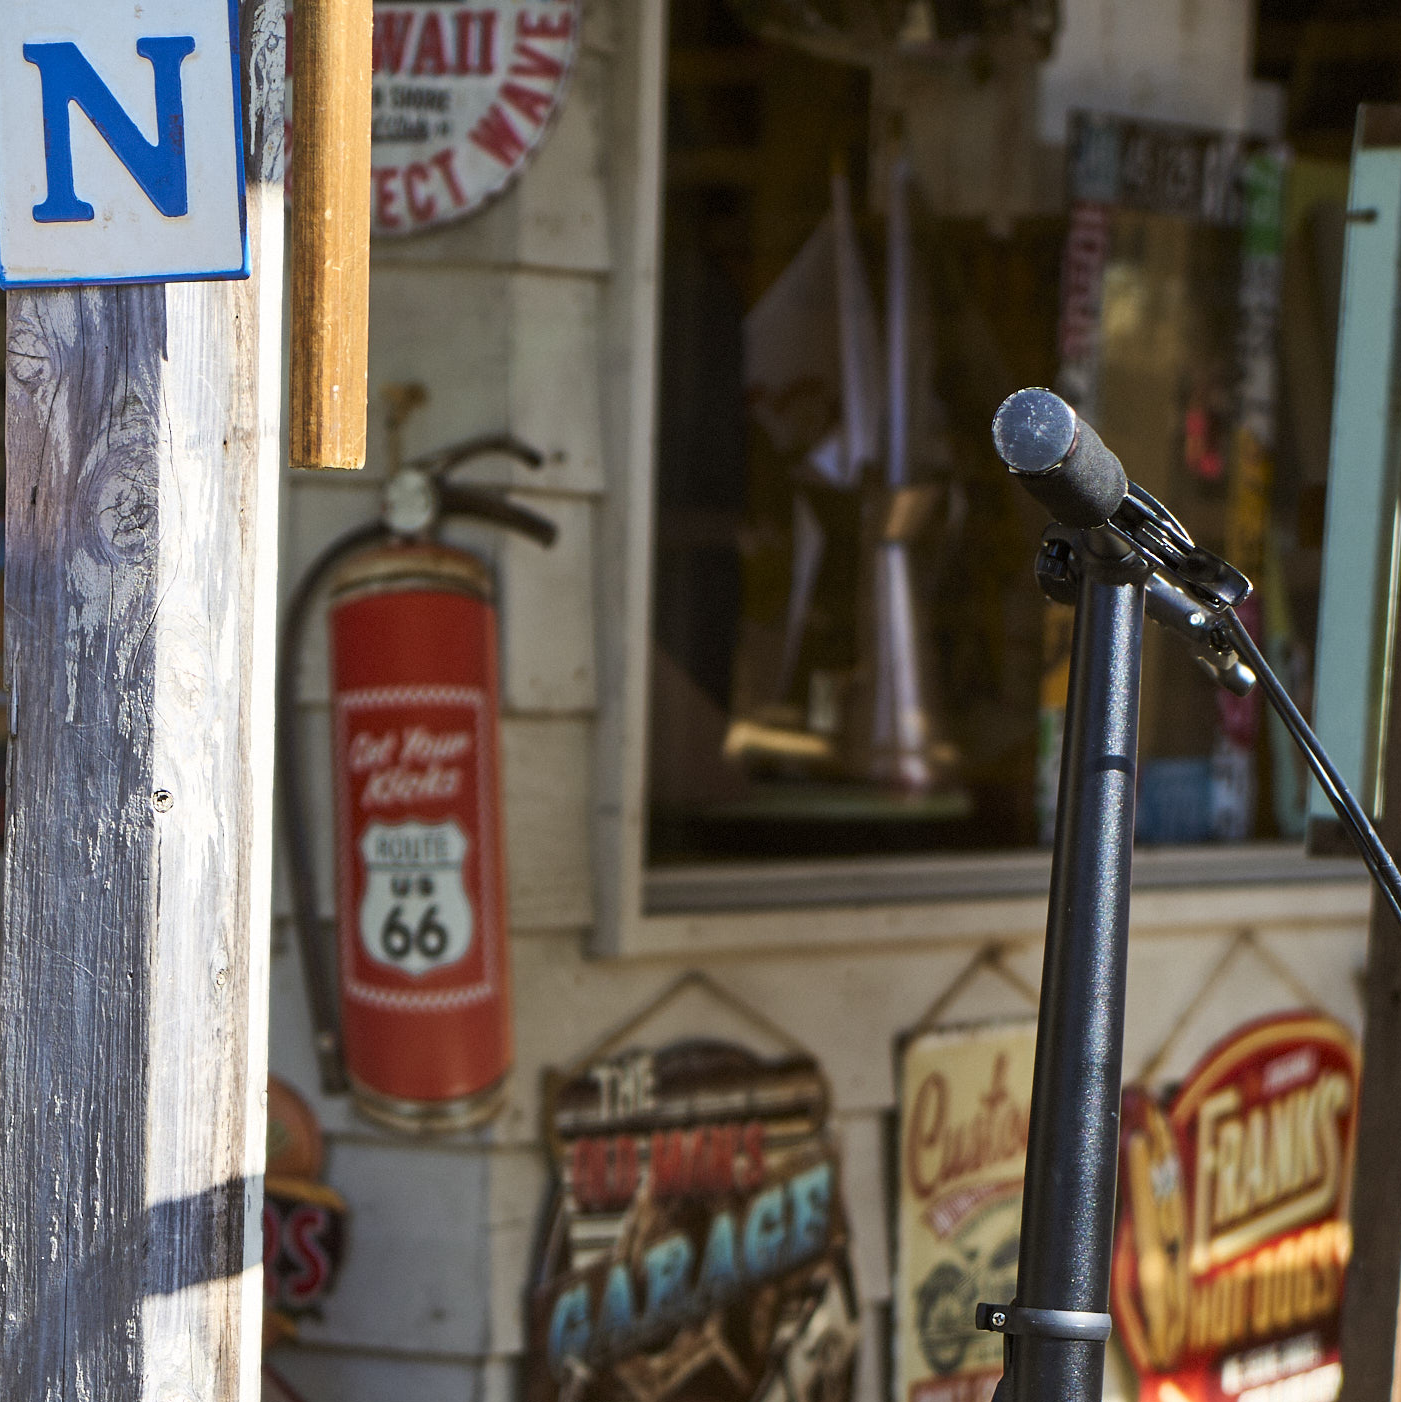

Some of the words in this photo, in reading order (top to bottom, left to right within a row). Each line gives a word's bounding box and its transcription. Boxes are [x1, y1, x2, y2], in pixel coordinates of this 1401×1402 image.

[372, 8, 497, 76] WAII
[23, 36, 196, 223] N
[374, 832, 449, 860] ROUTE
[380, 902, 449, 960] 66
[548, 1162, 832, 1375] GARAGE
